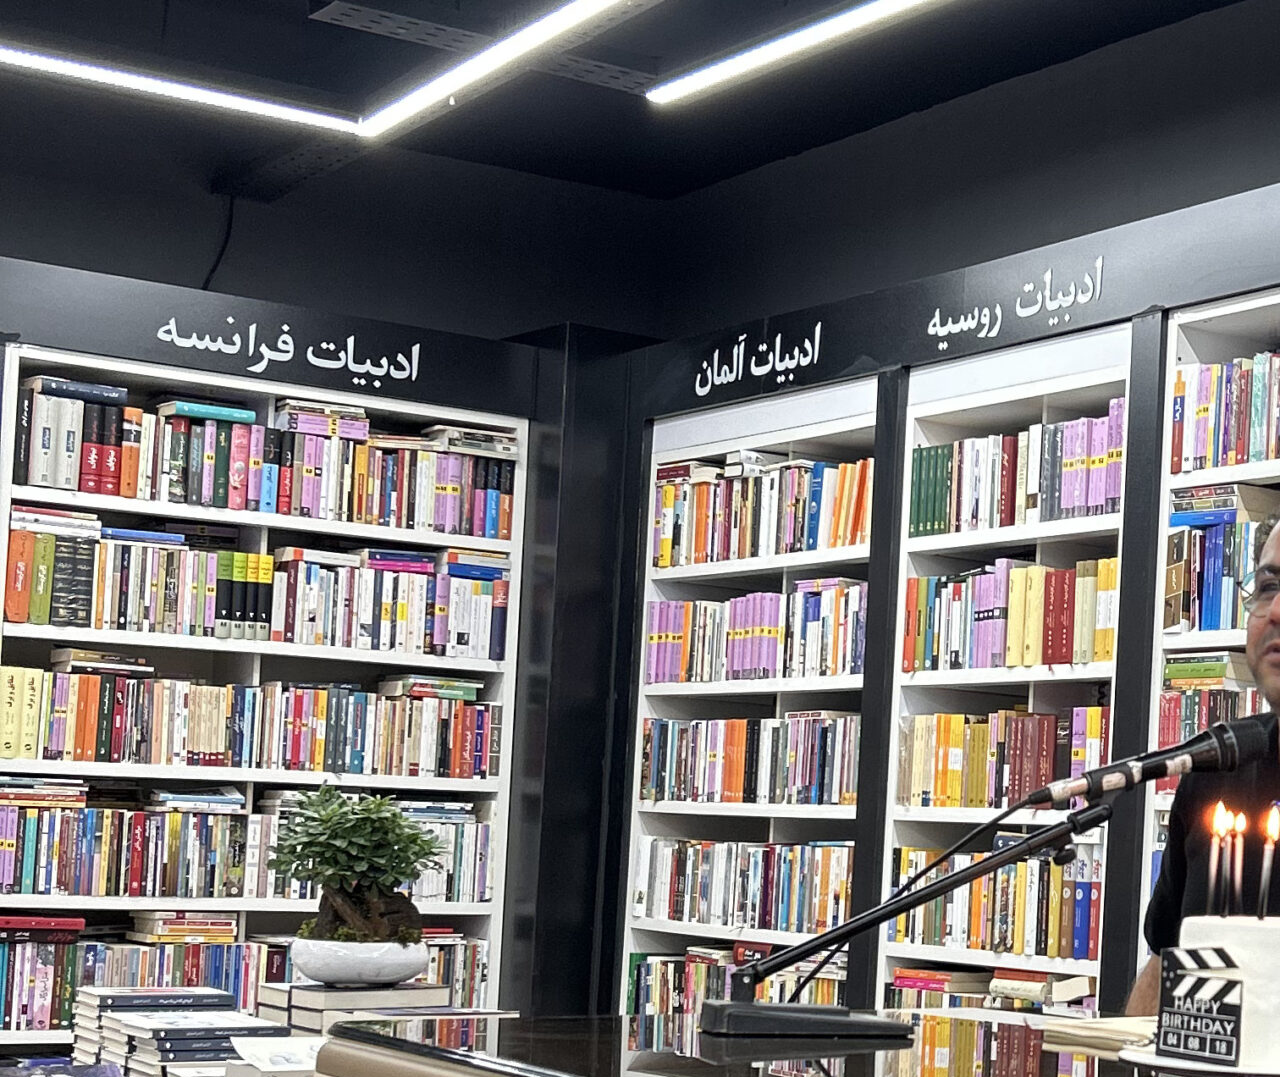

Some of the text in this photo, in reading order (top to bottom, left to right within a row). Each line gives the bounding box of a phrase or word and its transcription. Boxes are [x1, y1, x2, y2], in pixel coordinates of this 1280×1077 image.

[927, 255, 1104, 352] ادبیات روسیه
[157, 316, 420, 389] ادبیات فرانسه
[695, 322, 822, 397] ادبیات آلمان
[1162, 1012, 1236, 1036] BIRTHDAY
[1174, 996, 1221, 1014] HAPPY
